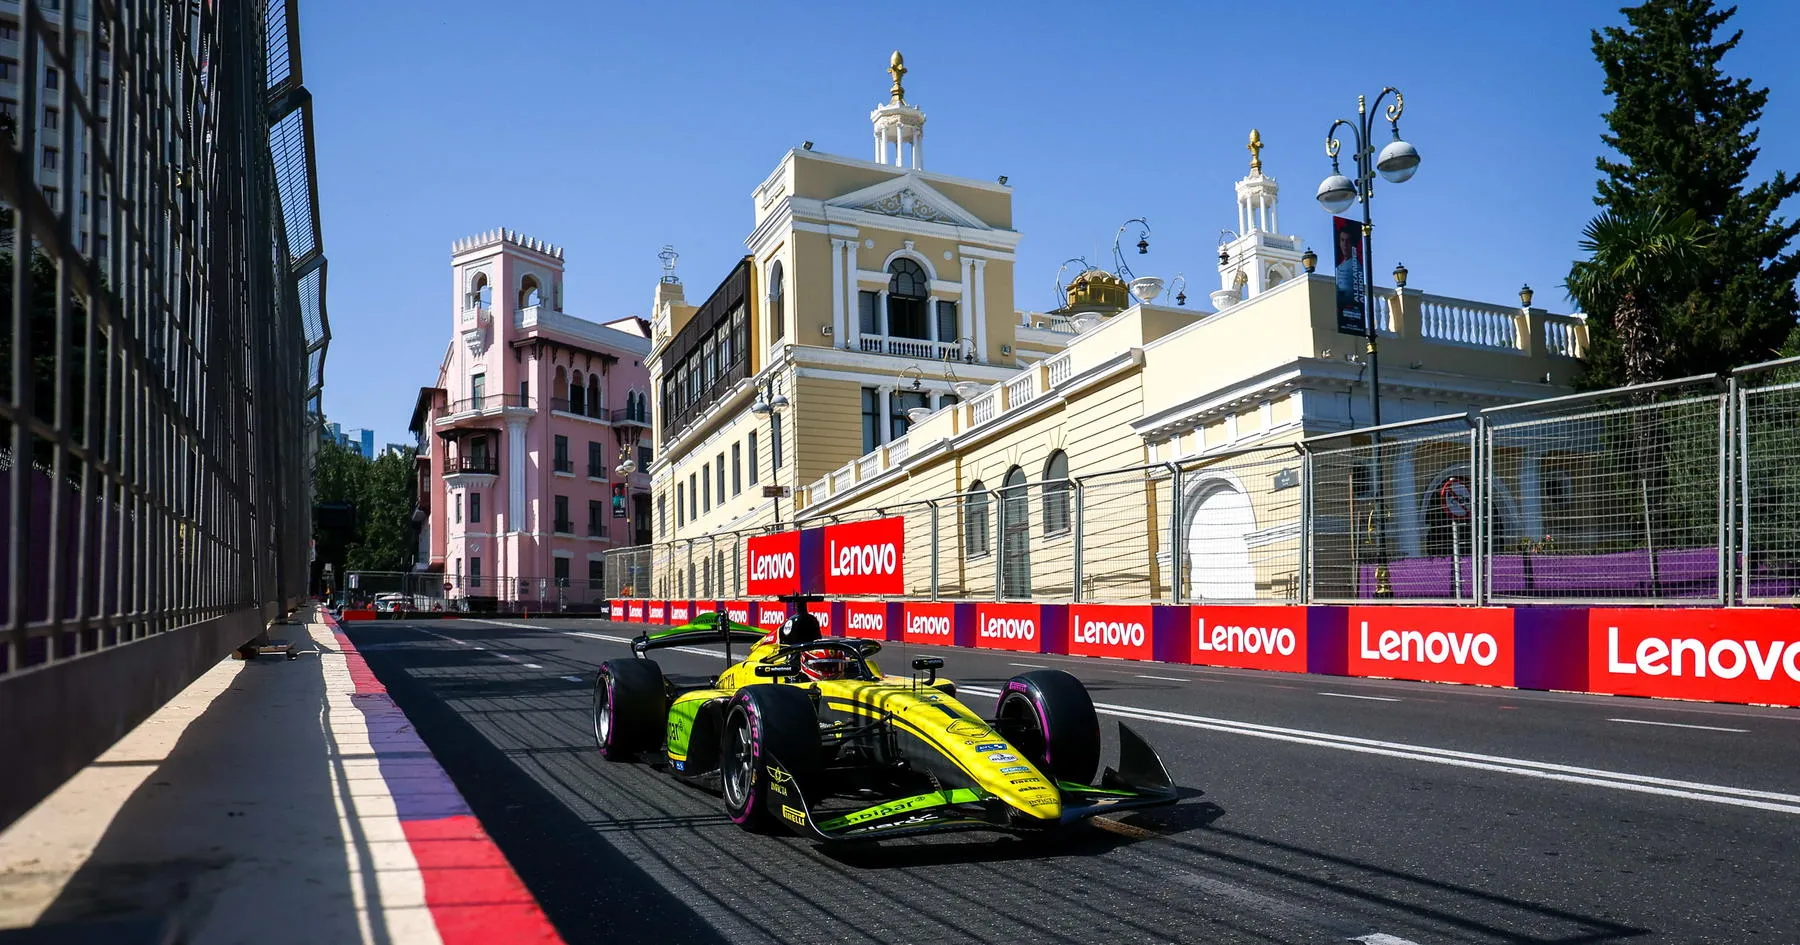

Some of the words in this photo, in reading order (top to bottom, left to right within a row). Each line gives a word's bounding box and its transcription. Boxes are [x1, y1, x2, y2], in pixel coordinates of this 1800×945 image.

[751, 550, 794, 580] Lenovo
[831, 540, 896, 576] Lenovo
[671, 606, 688, 620] Lenovo
[760, 607, 785, 624] Lenovo
[848, 609, 883, 630] Lenovo
[907, 611, 950, 635] Lenovo
[980, 612, 1035, 640] Lenovo
[1074, 615, 1145, 646] Lenovo
[1198, 618, 1296, 656] Lenovo
[1361, 621, 1498, 666] Lenovo
[782, 804, 806, 826] PIRELLI
